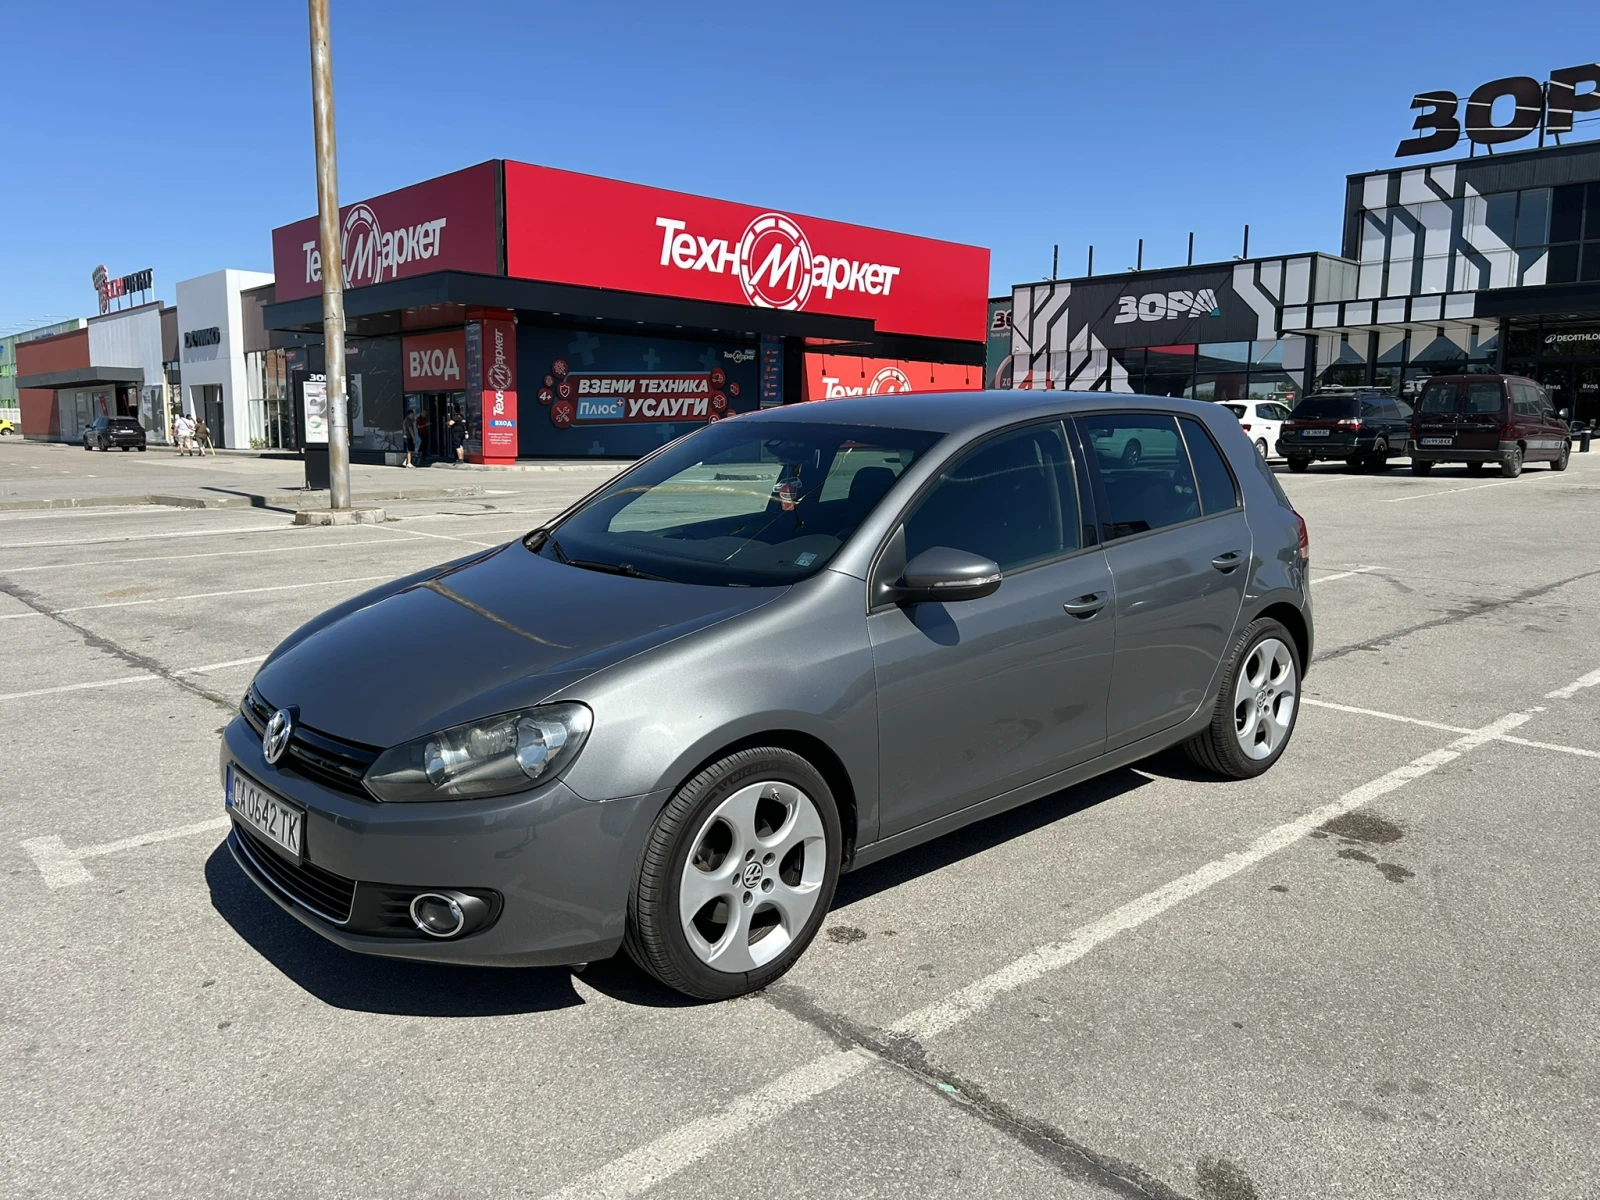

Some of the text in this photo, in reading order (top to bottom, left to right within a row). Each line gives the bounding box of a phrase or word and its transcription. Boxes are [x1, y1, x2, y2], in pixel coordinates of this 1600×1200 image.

[1114, 288, 1220, 324] ЗОРА
[410, 348, 459, 380] ВХОД
[578, 379, 708, 394] ВЗЕМИ ТЕХНИКА
[628, 398, 709, 417] УСЛУГИ
